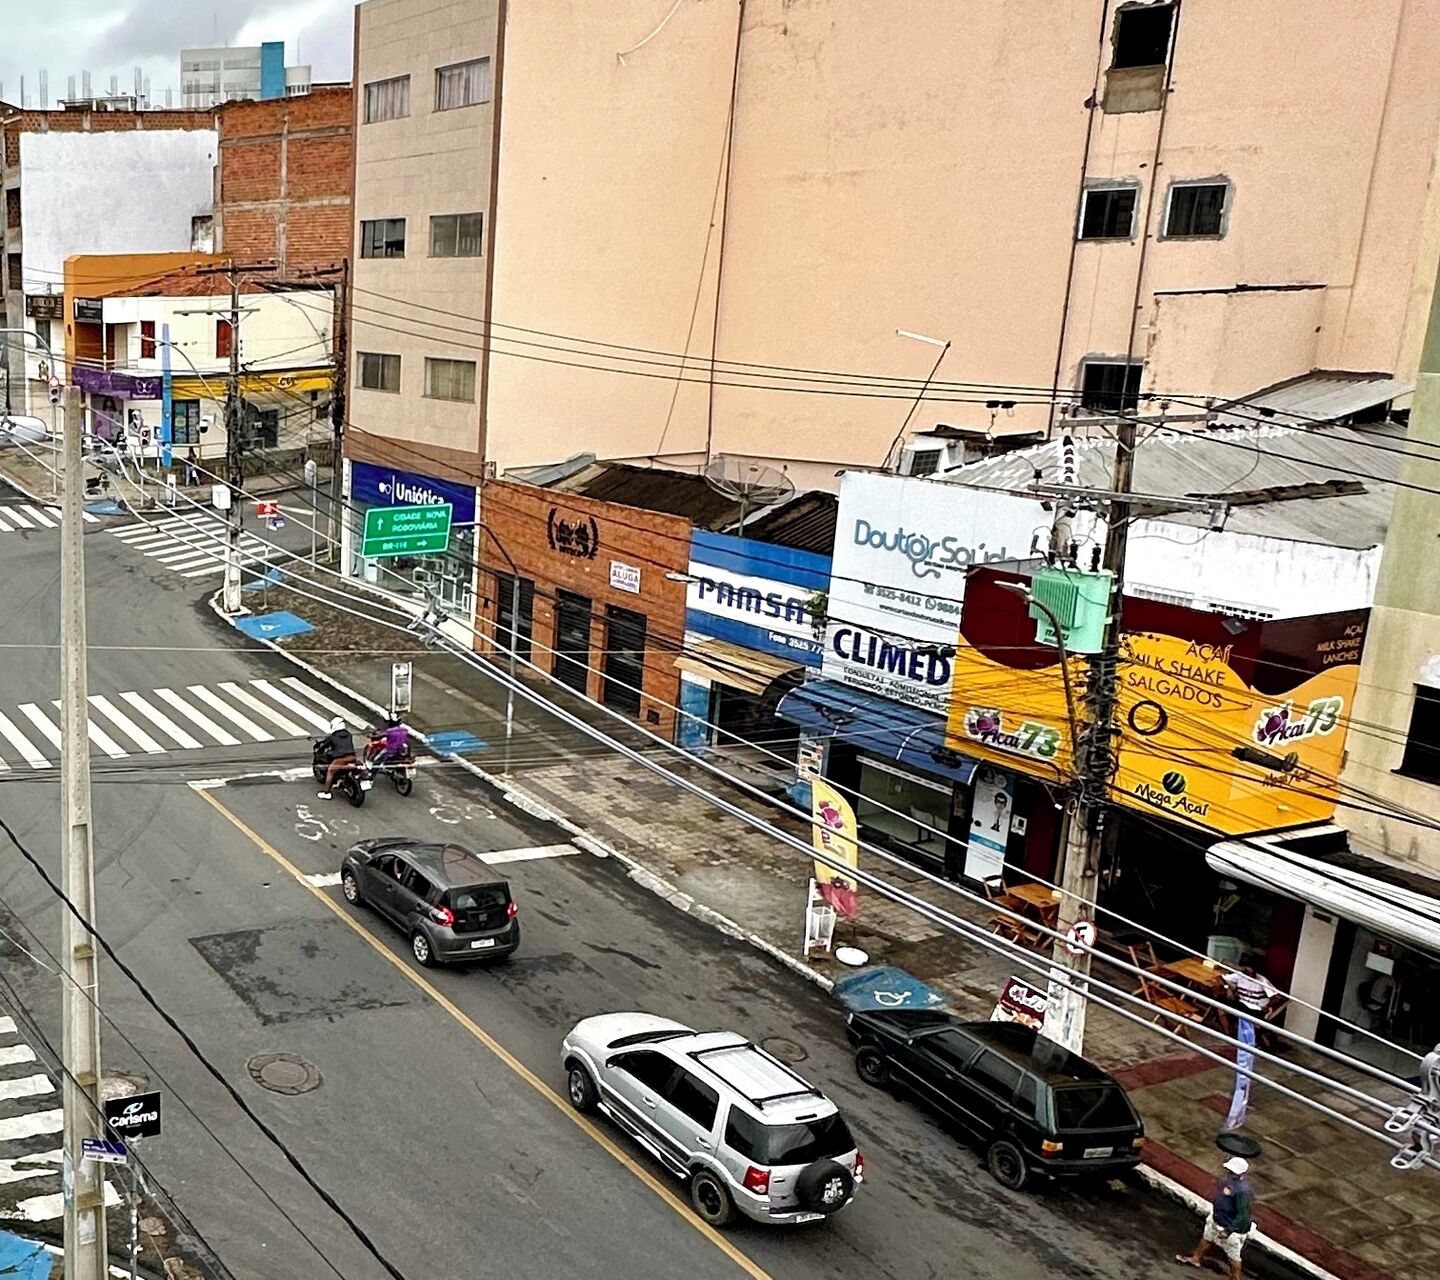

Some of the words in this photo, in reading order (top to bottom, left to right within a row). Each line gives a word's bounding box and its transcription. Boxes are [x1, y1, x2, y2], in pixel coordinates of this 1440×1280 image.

[393, 512, 422, 522] CIDADE
[426, 510, 447, 519] NOVA
[833, 628, 951, 686] CLIMED
[1170, 660, 1226, 686] SHAKE
[1127, 672, 1222, 708] SALGADOS
[1306, 698, 1342, 733] 73
[1021, 722, 1061, 756] 73
[1135, 783, 1171, 807] Mega
